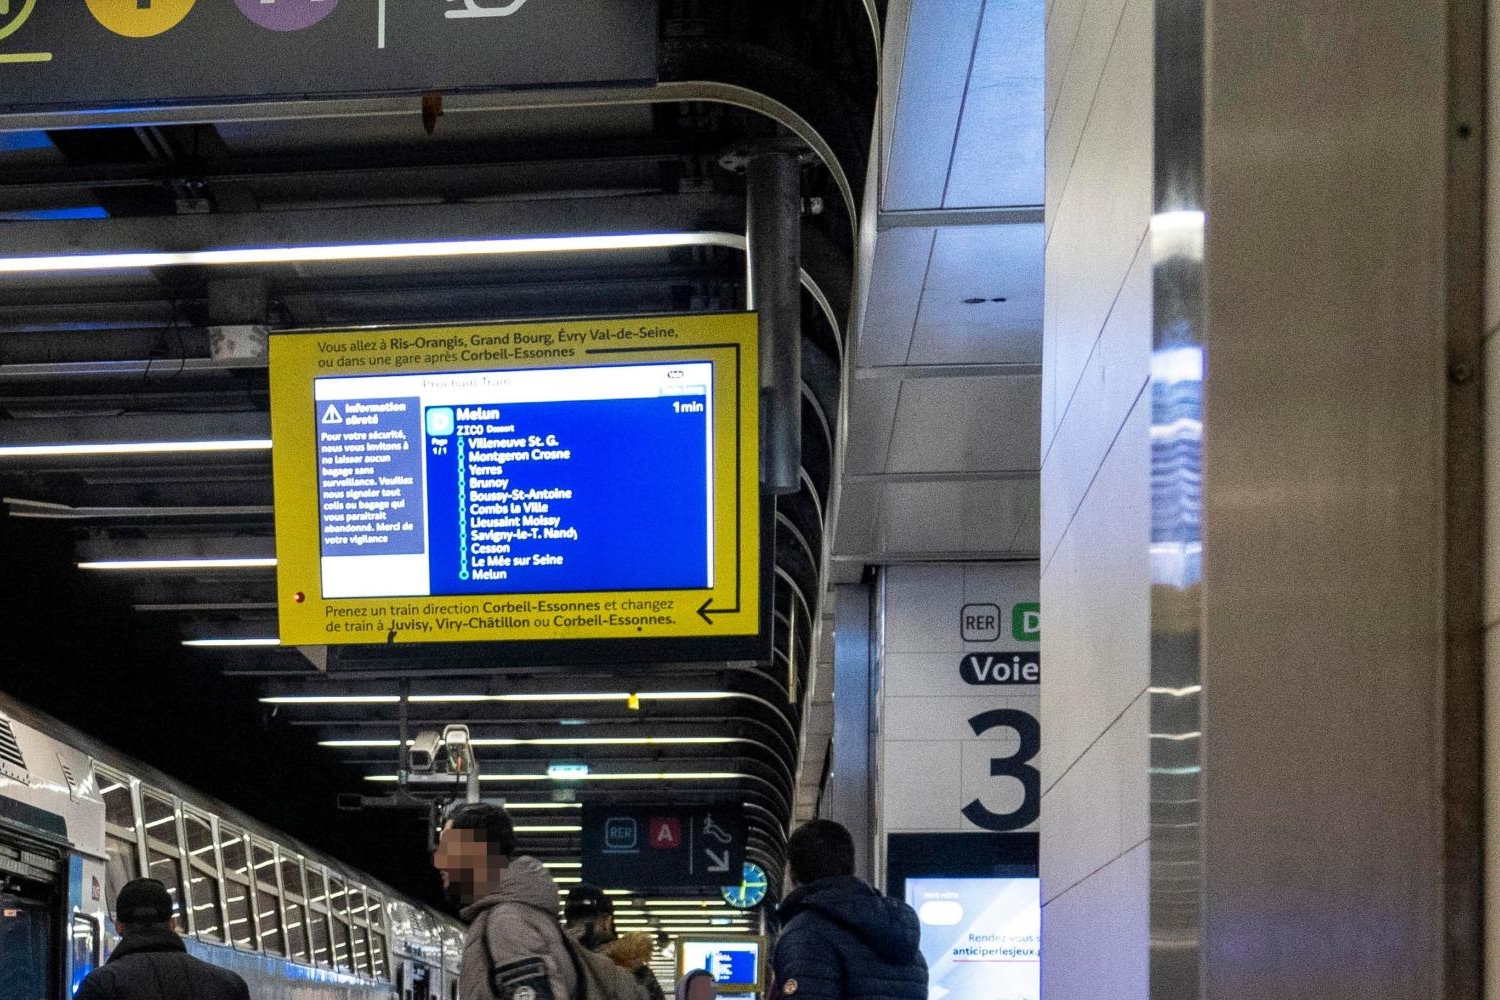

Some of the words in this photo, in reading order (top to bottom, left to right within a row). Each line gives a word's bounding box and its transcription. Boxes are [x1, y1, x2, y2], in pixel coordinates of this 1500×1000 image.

[318, 341, 347, 353] Vous
[350, 340, 377, 352] allez
[380, 338, 387, 350] à
[390, 335, 467, 350] Ris-Orangis,
[471, 333, 510, 346] Grand
[513, 332, 554, 346] Bourg,
[558, 328, 587, 344] Évry
[590, 326, 678, 341] Val-de-Seine,
[318, 359, 333, 368] ou
[337, 356, 365, 367] dans
[369, 357, 392, 365] une
[395, 354, 421, 367] gare
[424, 352, 458, 366] après
[461, 346, 576, 361] Corbeil-Essonnes
[345, 401, 407, 414] Information
[456, 407, 500, 421] Melun
[321, 432, 342, 441] Pour
[343, 432, 367, 440] votre
[468, 437, 526, 449] Villeneuve
[528, 435, 544, 447] St.
[546, 434, 559, 446] G.
[321, 444, 343, 453] nous
[344, 444, 365, 452] vous
[366, 442, 402, 451] invitons
[321, 456, 333, 464] ne
[334, 455, 363, 464] laisser
[364, 455, 391, 463] aucun
[469, 450, 529, 464] Montgeron
[531, 448, 571, 460] Crosne
[322, 466, 354, 477] bagage
[355, 467, 374, 475] sans
[468, 464, 503, 476] Yerres
[379, 475, 414, 485] Veuillez
[469, 477, 509, 490] Brunoy
[345, 489, 380, 499] signaler
[381, 488, 402, 497] tout
[469, 487, 572, 503] Boussy-St-Antoine
[323, 501, 344, 510] colis
[358, 500, 389, 511] bagage
[391, 498, 405, 510] qui
[470, 503, 509, 515] Combs
[510, 502, 522, 514] la
[522, 501, 549, 513] Ville
[376, 522, 400, 531] Merci
[402, 522, 414, 531] de
[470, 516, 521, 528] Lieusaint
[522, 514, 560, 528] Moissy
[324, 536, 348, 544] votre
[349, 535, 388, 546] vigilance
[470, 542, 510, 554] Cesson
[471, 556, 485, 567] Le
[487, 554, 511, 566] Mée
[513, 556, 531, 566] sur
[532, 554, 564, 565] Seine
[472, 568, 507, 580] Melun
[325, 605, 368, 617] Prenez
[371, 607, 386, 616] un
[390, 604, 419, 616] train
[423, 602, 479, 615] direction
[483, 600, 601, 614] Corbeil-Essonnes
[604, 600, 617, 611] et
[621, 599, 674, 613] changez
[325, 621, 341, 632] de
[345, 620, 373, 632] train
[377, 620, 384, 631] à
[387, 618, 433, 633] Juvisy,
[436, 616, 530, 632] Viry-Châtillon
[534, 618, 550, 628] ou
[553, 614, 676, 627] Corbeil-Essonnes.
[966, 615, 995, 630] RER
[1023, 611, 1040, 632] D
[970, 655, 1039, 681] Voie
[961, 708, 1041, 831] 3
[609, 826, 632, 839] RER
[657, 823, 673, 841] A
